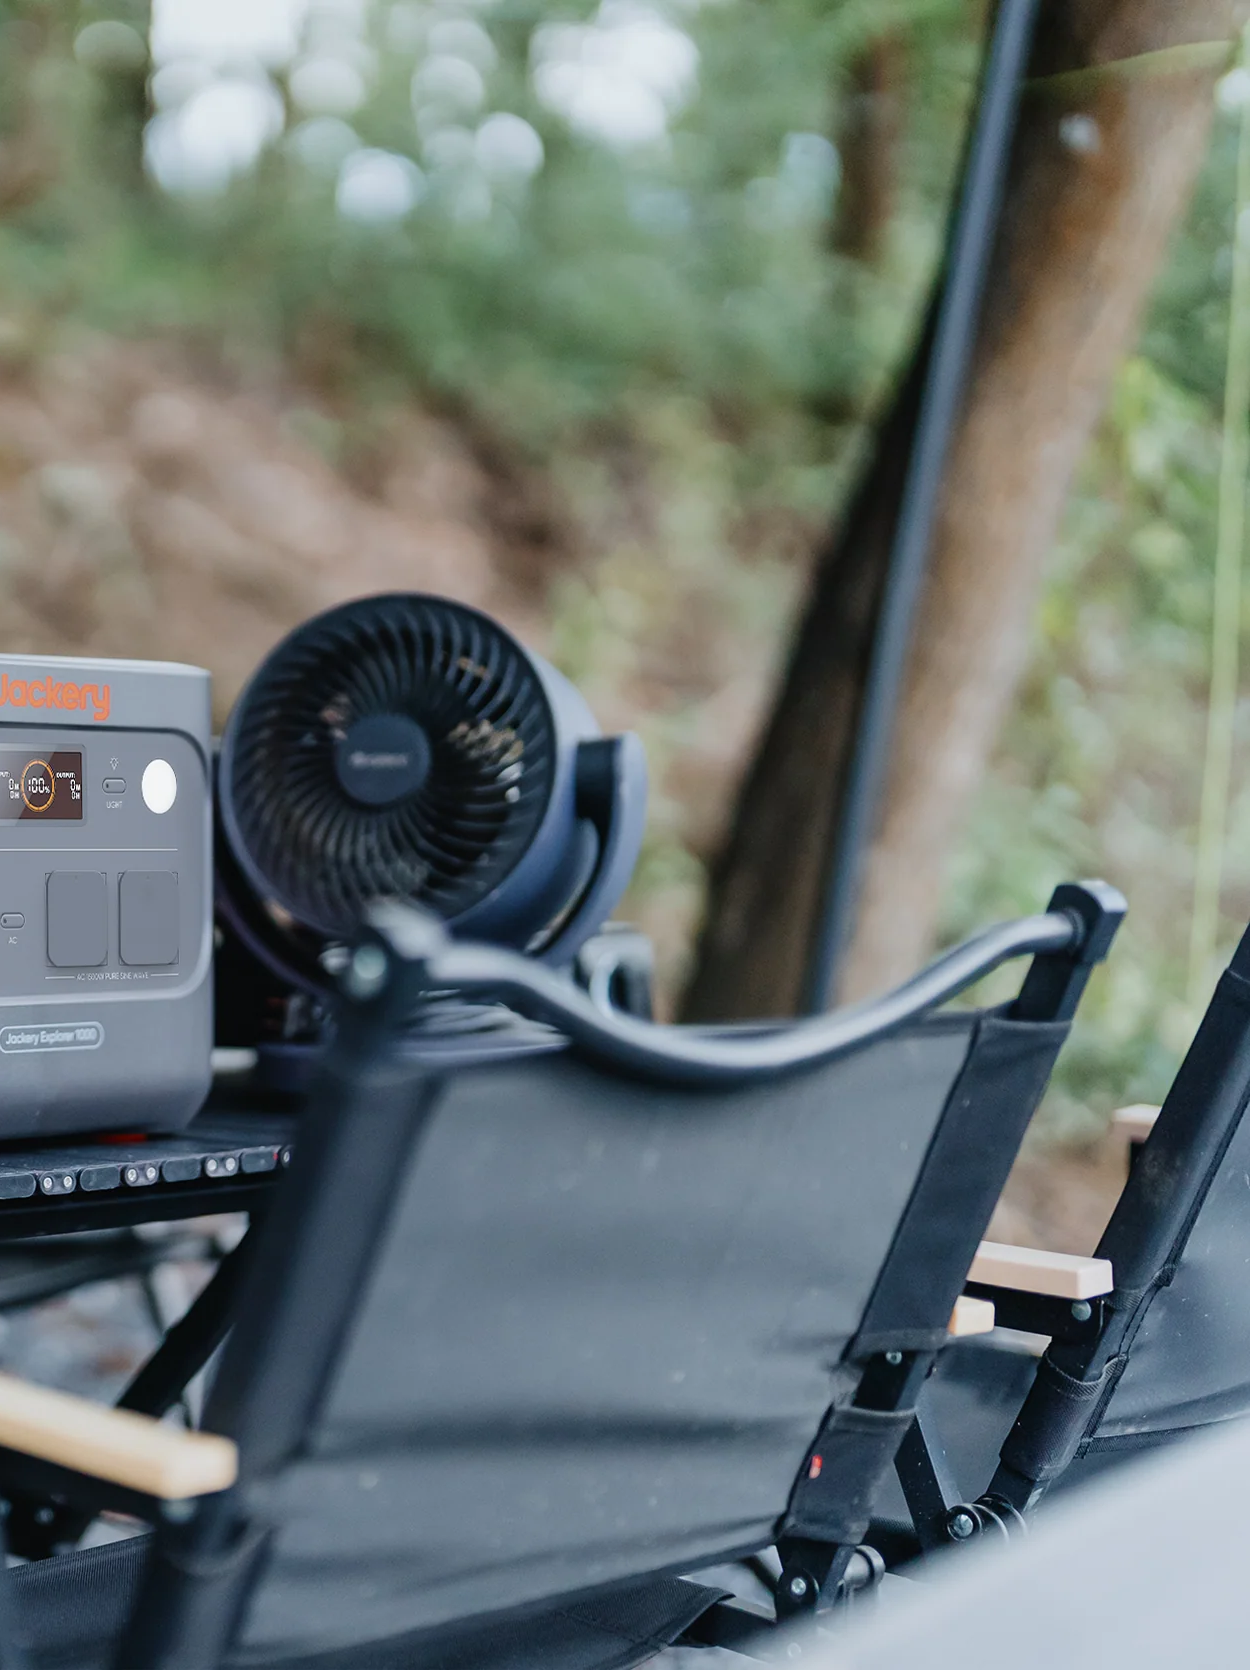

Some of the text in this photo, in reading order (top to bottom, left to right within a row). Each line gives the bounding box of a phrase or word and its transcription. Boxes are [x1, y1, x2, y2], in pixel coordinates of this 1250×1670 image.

[28, 777, 51, 794] 100%
[8, 936, 18, 944] AC
[5, 1027, 98, 1046] Jackery Explorer 1000
